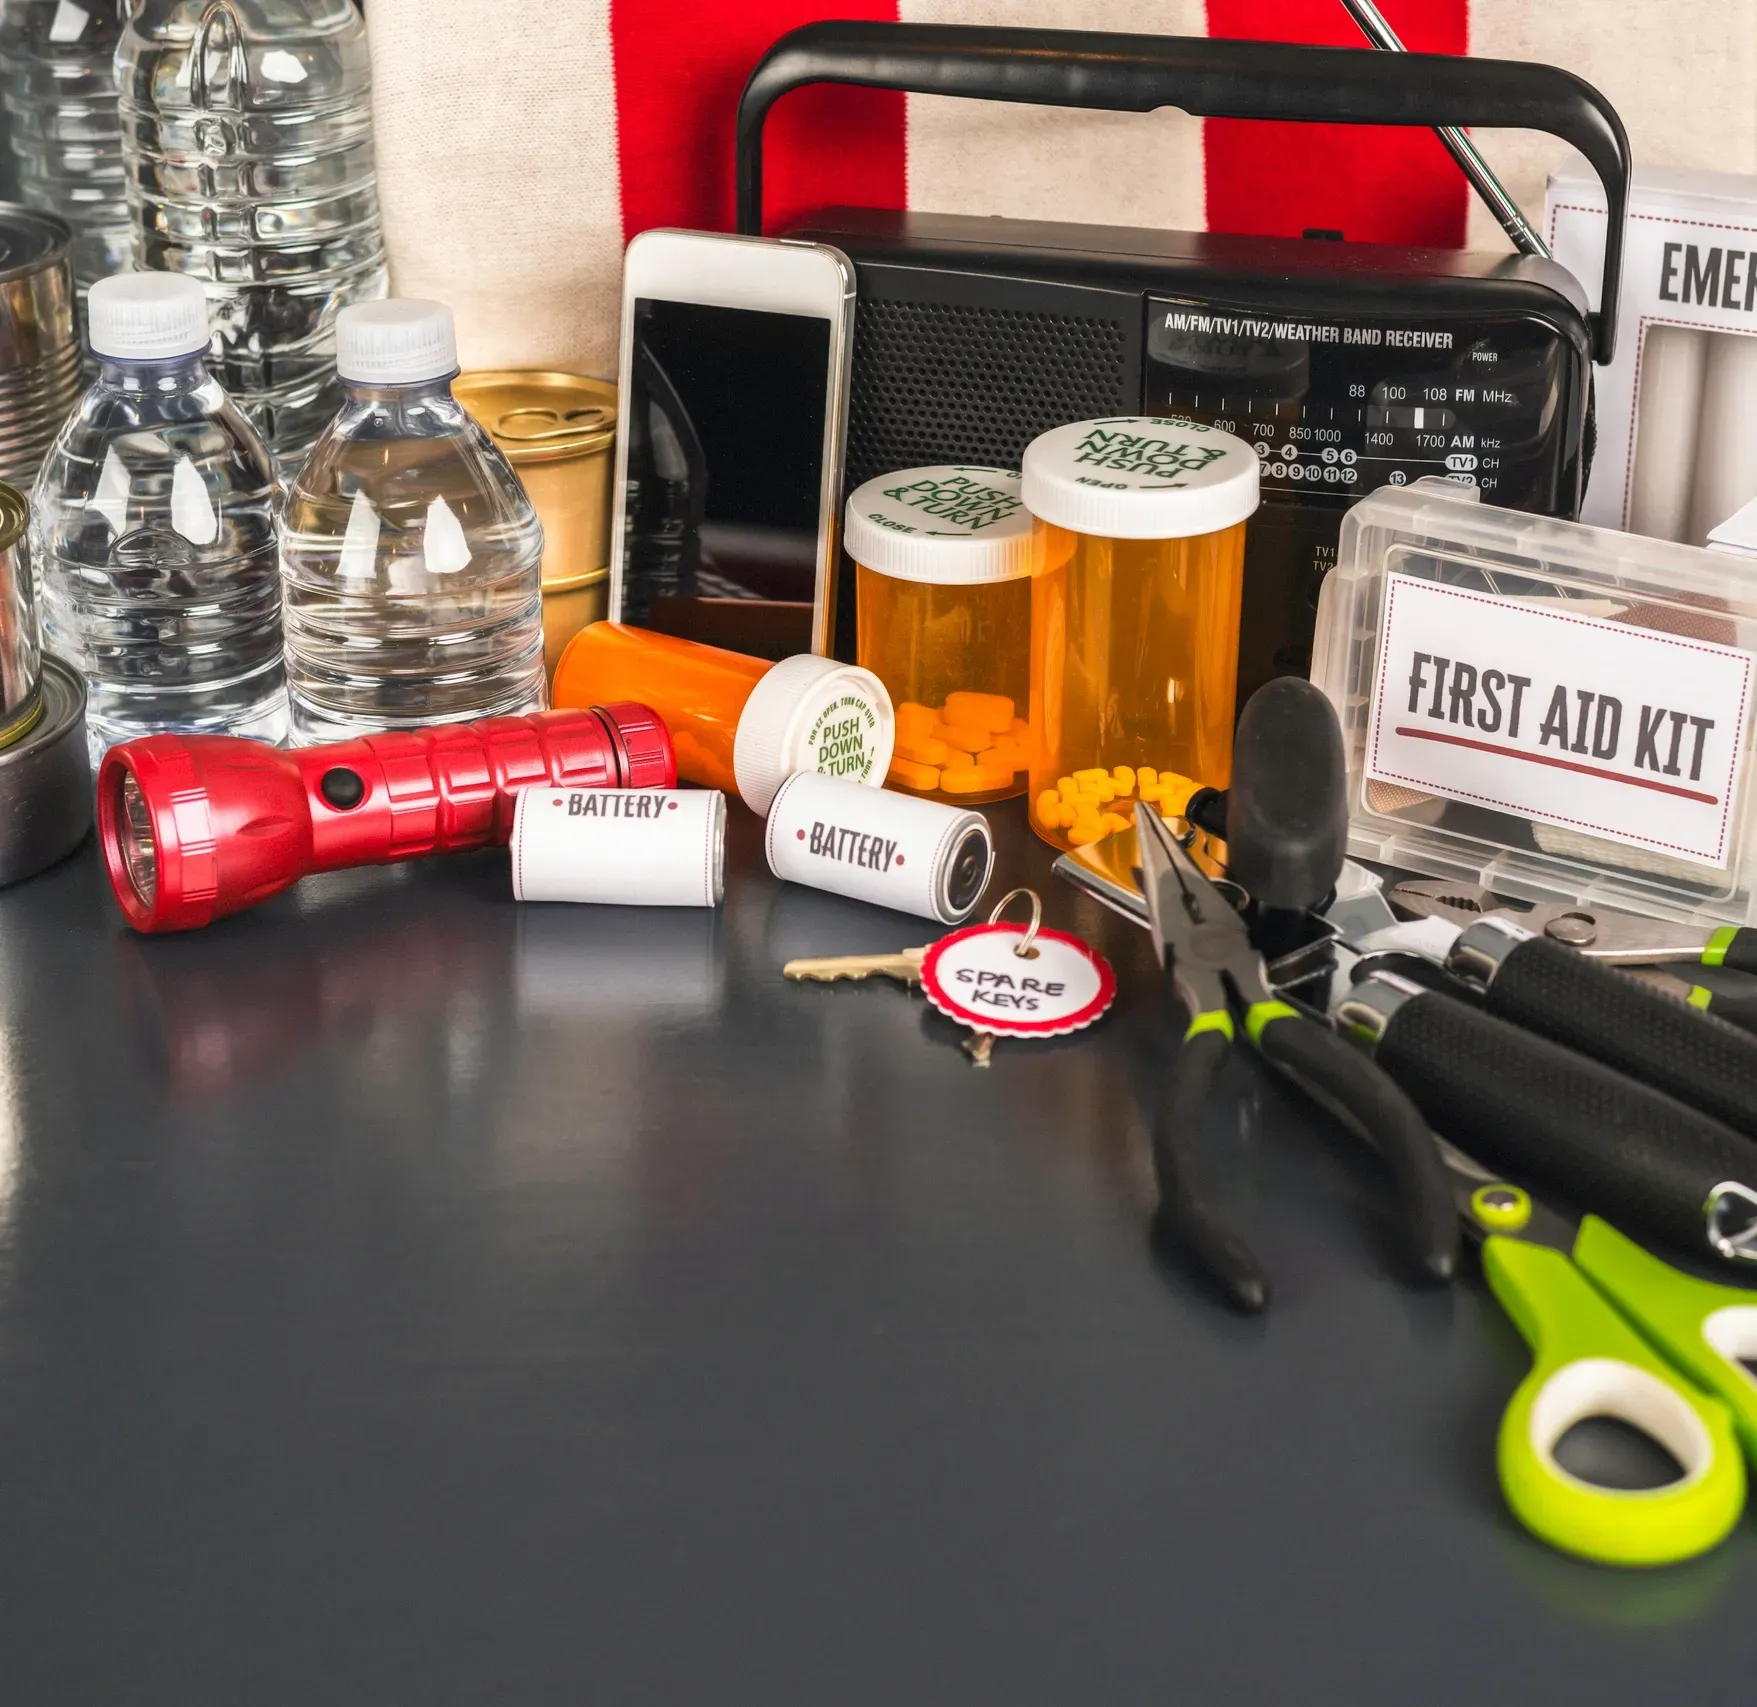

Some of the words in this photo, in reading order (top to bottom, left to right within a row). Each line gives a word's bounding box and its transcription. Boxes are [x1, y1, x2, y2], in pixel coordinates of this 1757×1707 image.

[1165, 313, 1340, 343] AM/FM/TV1/TV2/WEATHER
[1343, 327, 1382, 346] BAND
[1386, 331, 1453, 349] RECEIVER
[1472, 352, 1498, 362] POWER
[1349, 384, 1366, 398] 88
[1382, 386, 1406, 400] 100
[1423, 387, 1448, 401] 108
[1455, 389, 1475, 402] FM
[1482, 390, 1512, 403] MHz
[1149, 418, 1212, 433] CLOSE
[1214, 420, 1236, 433] 600
[1252, 423, 1275, 437] 700
[1289, 427, 1312, 441] 850
[1314, 429, 1342, 442] 1000
[1364, 432, 1394, 446] 1400
[1416, 434, 1446, 448] 1700
[1450, 436, 1475, 448] AM
[1480, 437, 1501, 449] kHz
[1074, 439, 1213, 471] DOWN
[1082, 428, 1190, 456] TURN
[1196, 446, 1227, 461] &
[1073, 452, 1185, 478] PUSH
[1450, 456, 1475, 469] TV1
[1482, 457, 1500, 469] CH
[940, 476, 1025, 510] PUSH
[1075, 476, 1129, 490] OPEN
[1481, 477, 1498, 489] CH
[882, 487, 910, 502] &
[907, 495, 997, 530] TURN
[906, 479, 1016, 521] DOWN
[867, 513, 918, 534] CLOSE
[1315, 546, 1335, 557] TV1
[808, 729, 818, 745] FOR
[815, 717, 824, 729] EZ
[840, 696, 856, 706] TURN
[855, 698, 867, 710] CAP
[864, 708, 876, 728] OVER
[1407, 651, 1531, 739] FIRST
[1538, 685, 1623, 761] AID
[1633, 705, 1715, 781] KIT
[823, 716, 860, 744] PUSH
[819, 733, 863, 764] DOWN
[828, 751, 865, 776] TURN
[568, 793, 667, 818] BATTERY
[809, 821, 898, 873] BATTERY
[956, 968, 1066, 997] SPARE
[972, 989, 1040, 1011] KEYS
